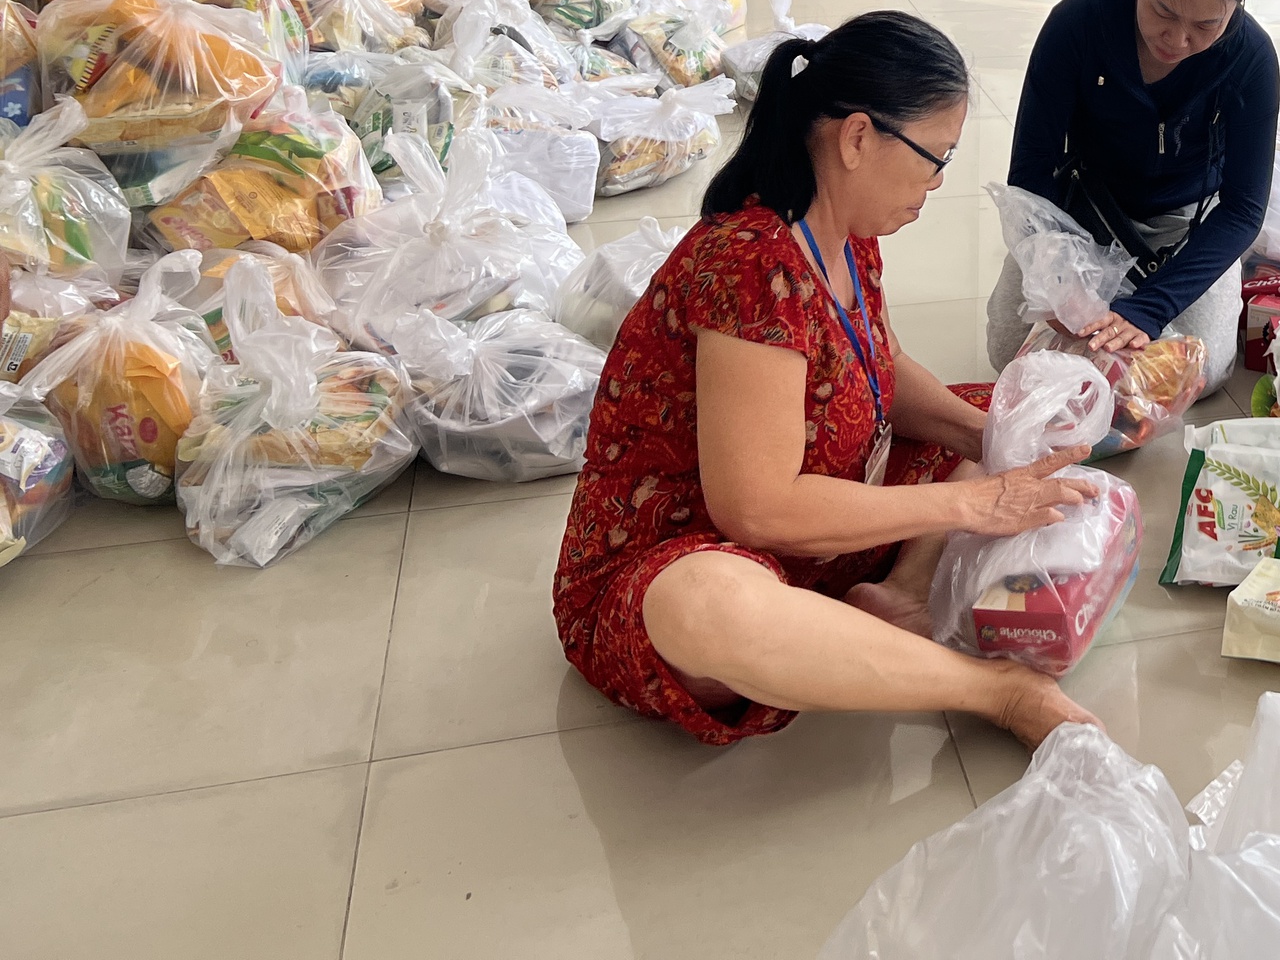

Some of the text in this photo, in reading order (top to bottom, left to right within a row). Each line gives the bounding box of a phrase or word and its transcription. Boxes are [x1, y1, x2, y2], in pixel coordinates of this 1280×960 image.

[1194, 488, 1218, 542] AFC
[1228, 504, 1238, 520] Rau
[1000, 626, 1057, 640] ChocoPie
